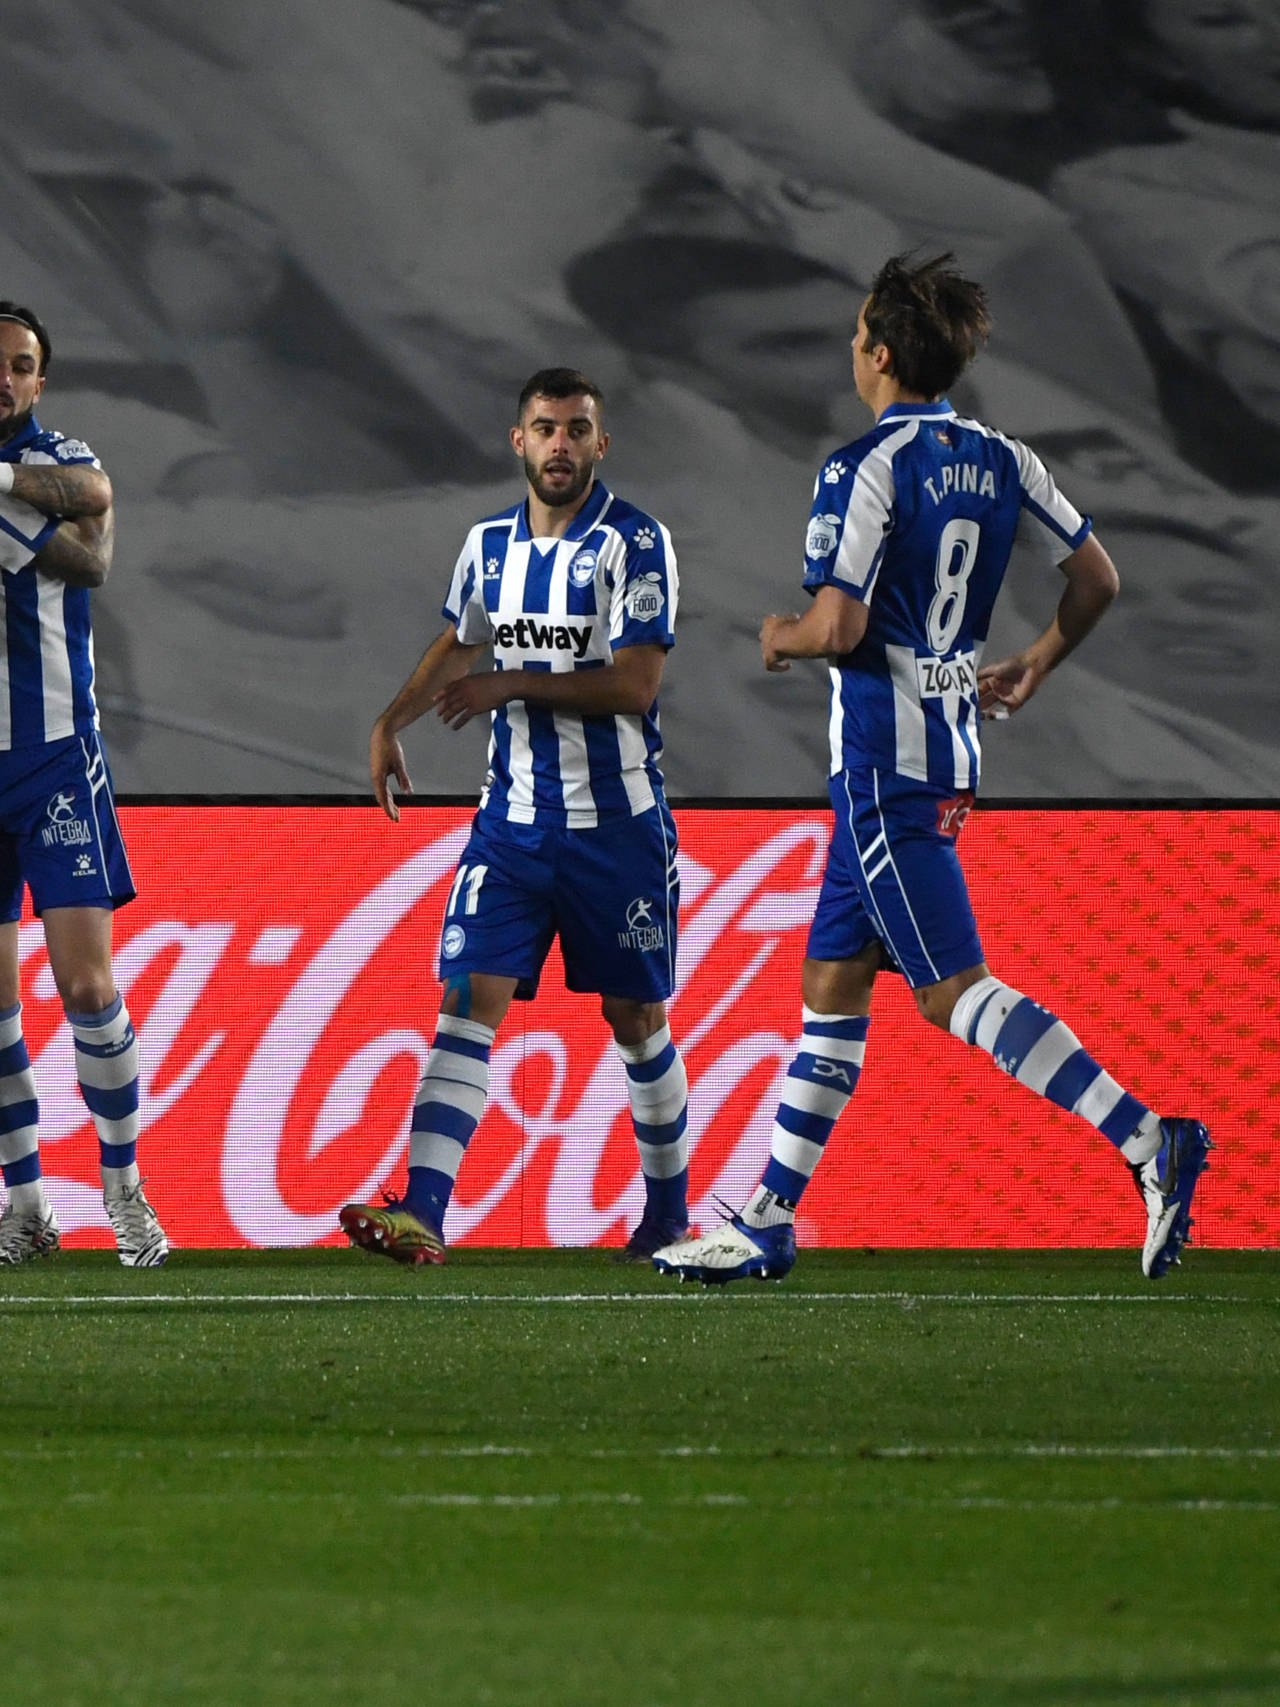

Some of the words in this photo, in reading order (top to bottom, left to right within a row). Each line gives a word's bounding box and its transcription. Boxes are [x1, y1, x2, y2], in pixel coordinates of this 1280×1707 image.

[924, 463, 996, 506] T.PINA
[926, 518, 980, 656] 8
[633, 597, 657, 613] FOOD
[42, 819, 91, 847] INTEGRA
[447, 864, 488, 916] 11
[617, 924, 664, 949] INTEGRA
